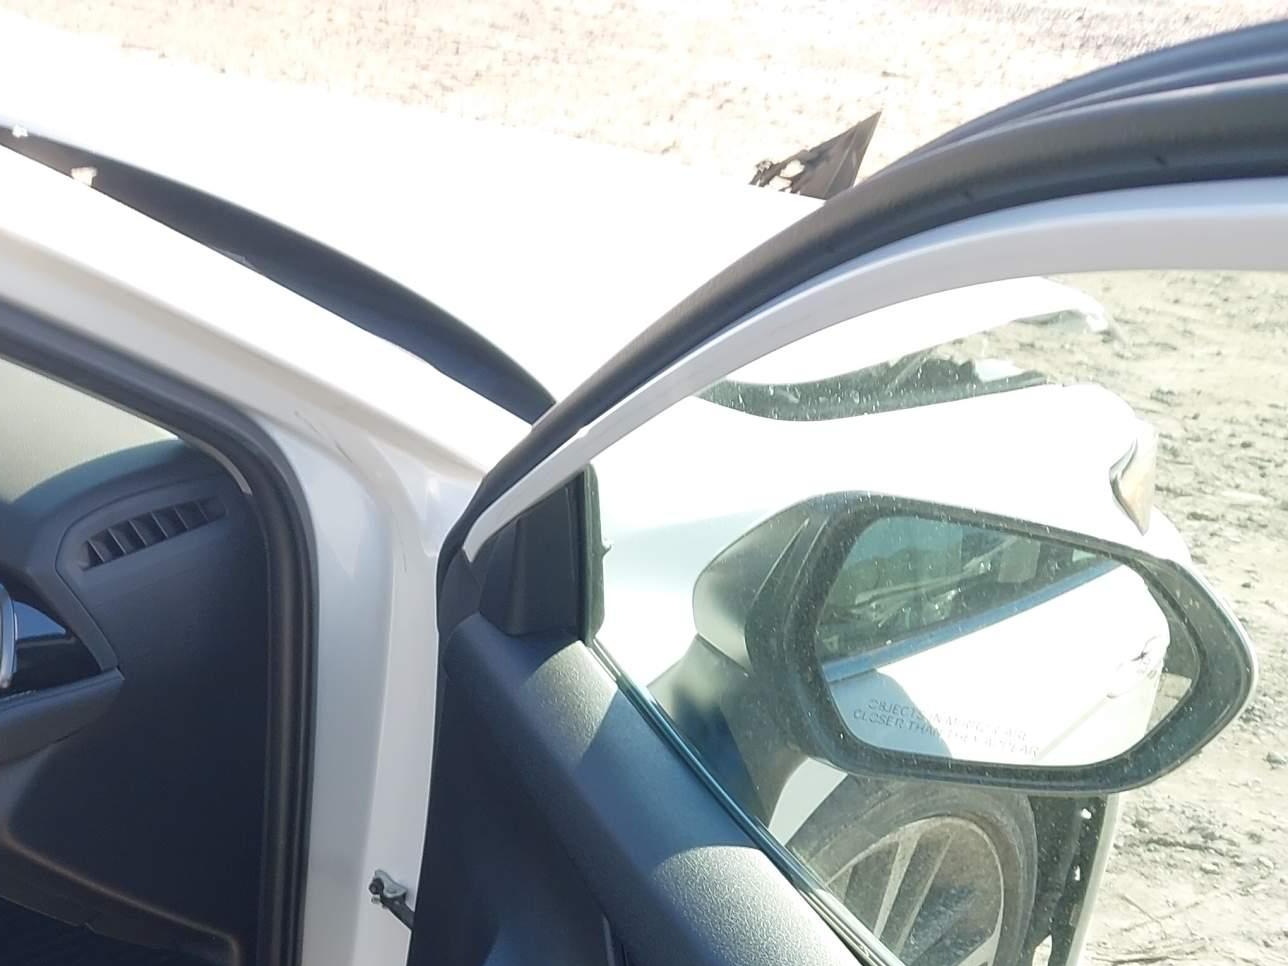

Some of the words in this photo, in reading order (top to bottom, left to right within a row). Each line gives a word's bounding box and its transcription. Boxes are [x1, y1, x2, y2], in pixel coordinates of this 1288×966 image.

[867, 698, 924, 720] OBJECTS
[853, 708, 904, 729] CLOSER
[908, 720, 941, 738] THAN
